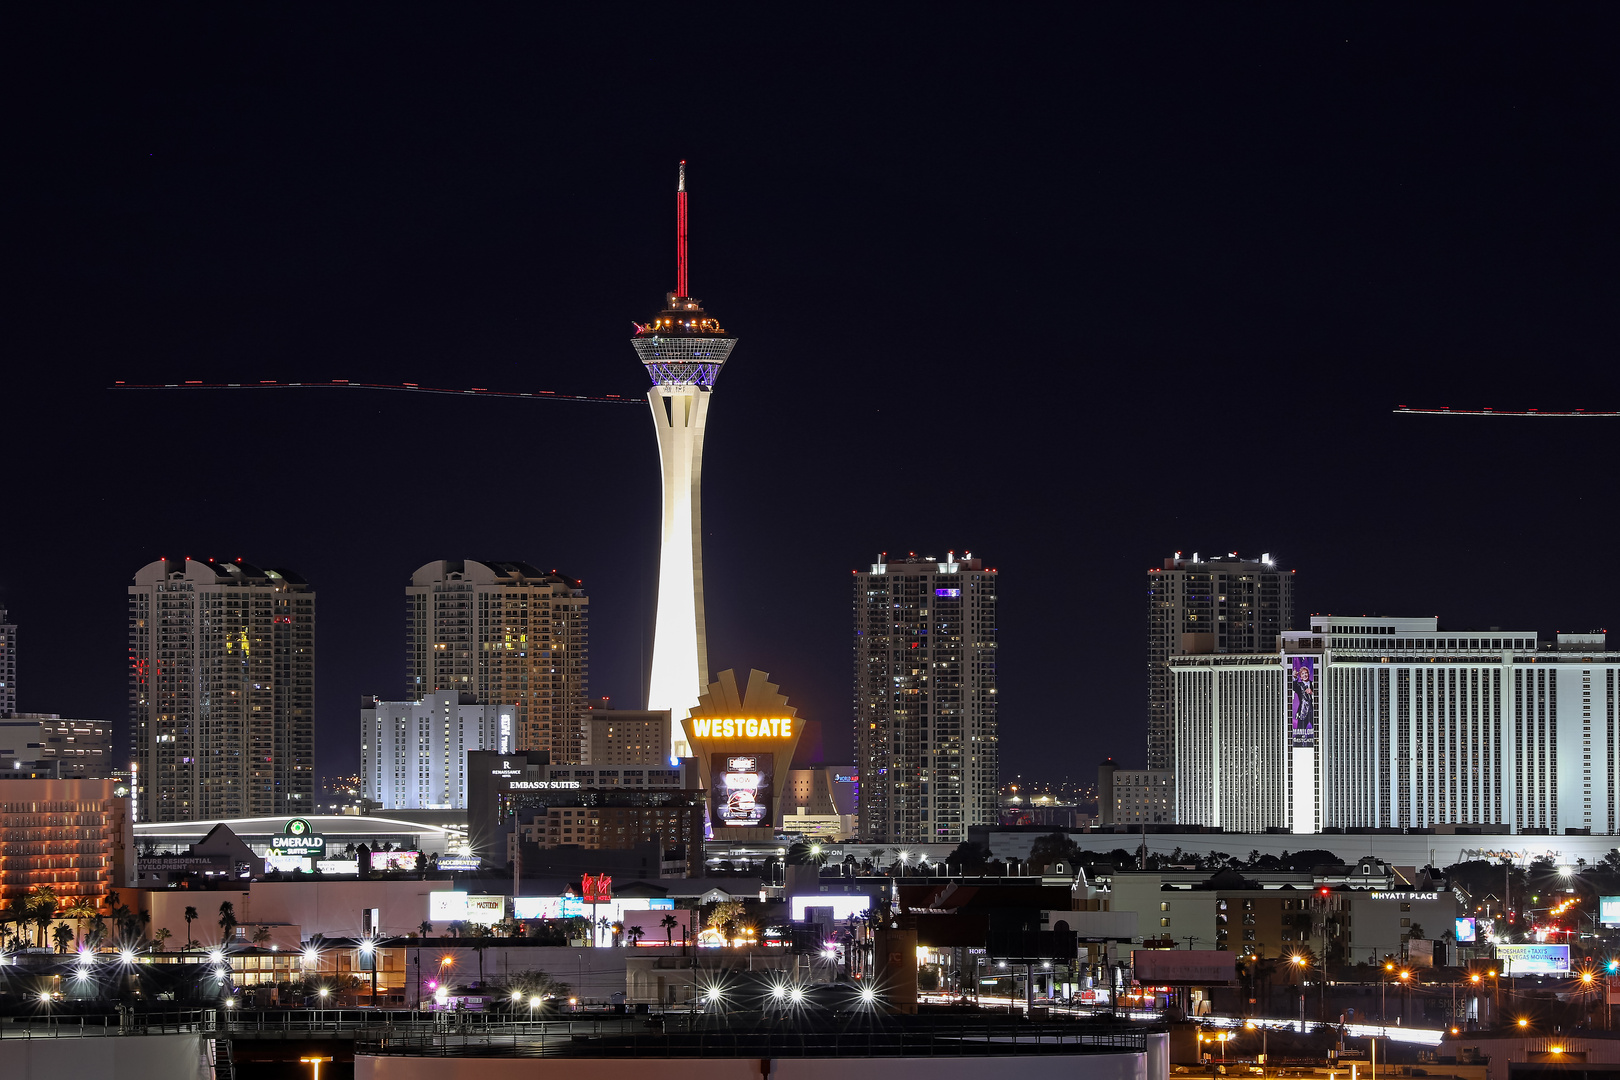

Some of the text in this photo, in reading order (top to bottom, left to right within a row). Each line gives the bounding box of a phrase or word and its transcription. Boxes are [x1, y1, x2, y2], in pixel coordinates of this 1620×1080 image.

[693, 718, 792, 738] WESTGATE
[504, 761, 510, 769] R
[272, 838, 323, 847] EMERALD
